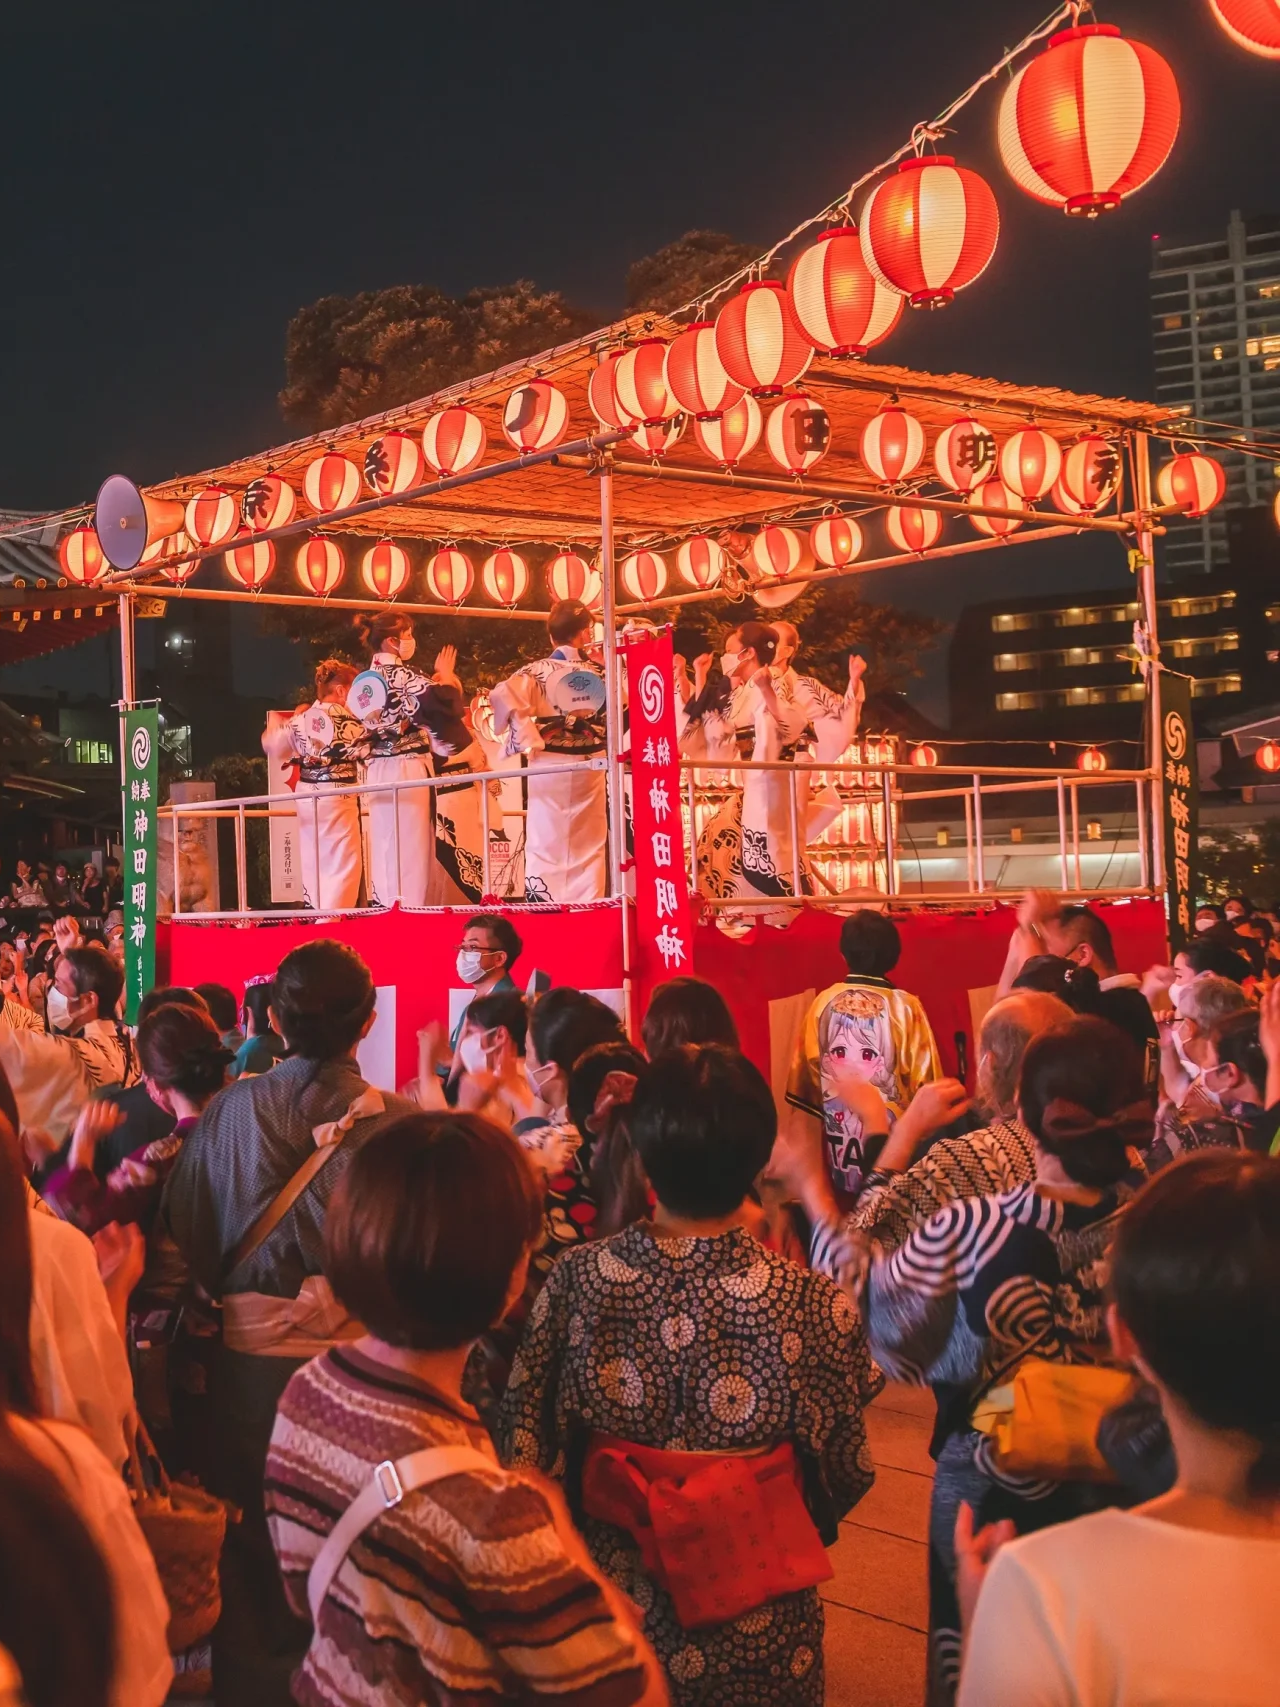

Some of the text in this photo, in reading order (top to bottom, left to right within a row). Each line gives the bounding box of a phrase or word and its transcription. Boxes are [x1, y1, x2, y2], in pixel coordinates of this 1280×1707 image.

[790, 407, 831, 454] 田
[956, 431, 997, 473] 明
[129, 808, 149, 950] 神田明神
